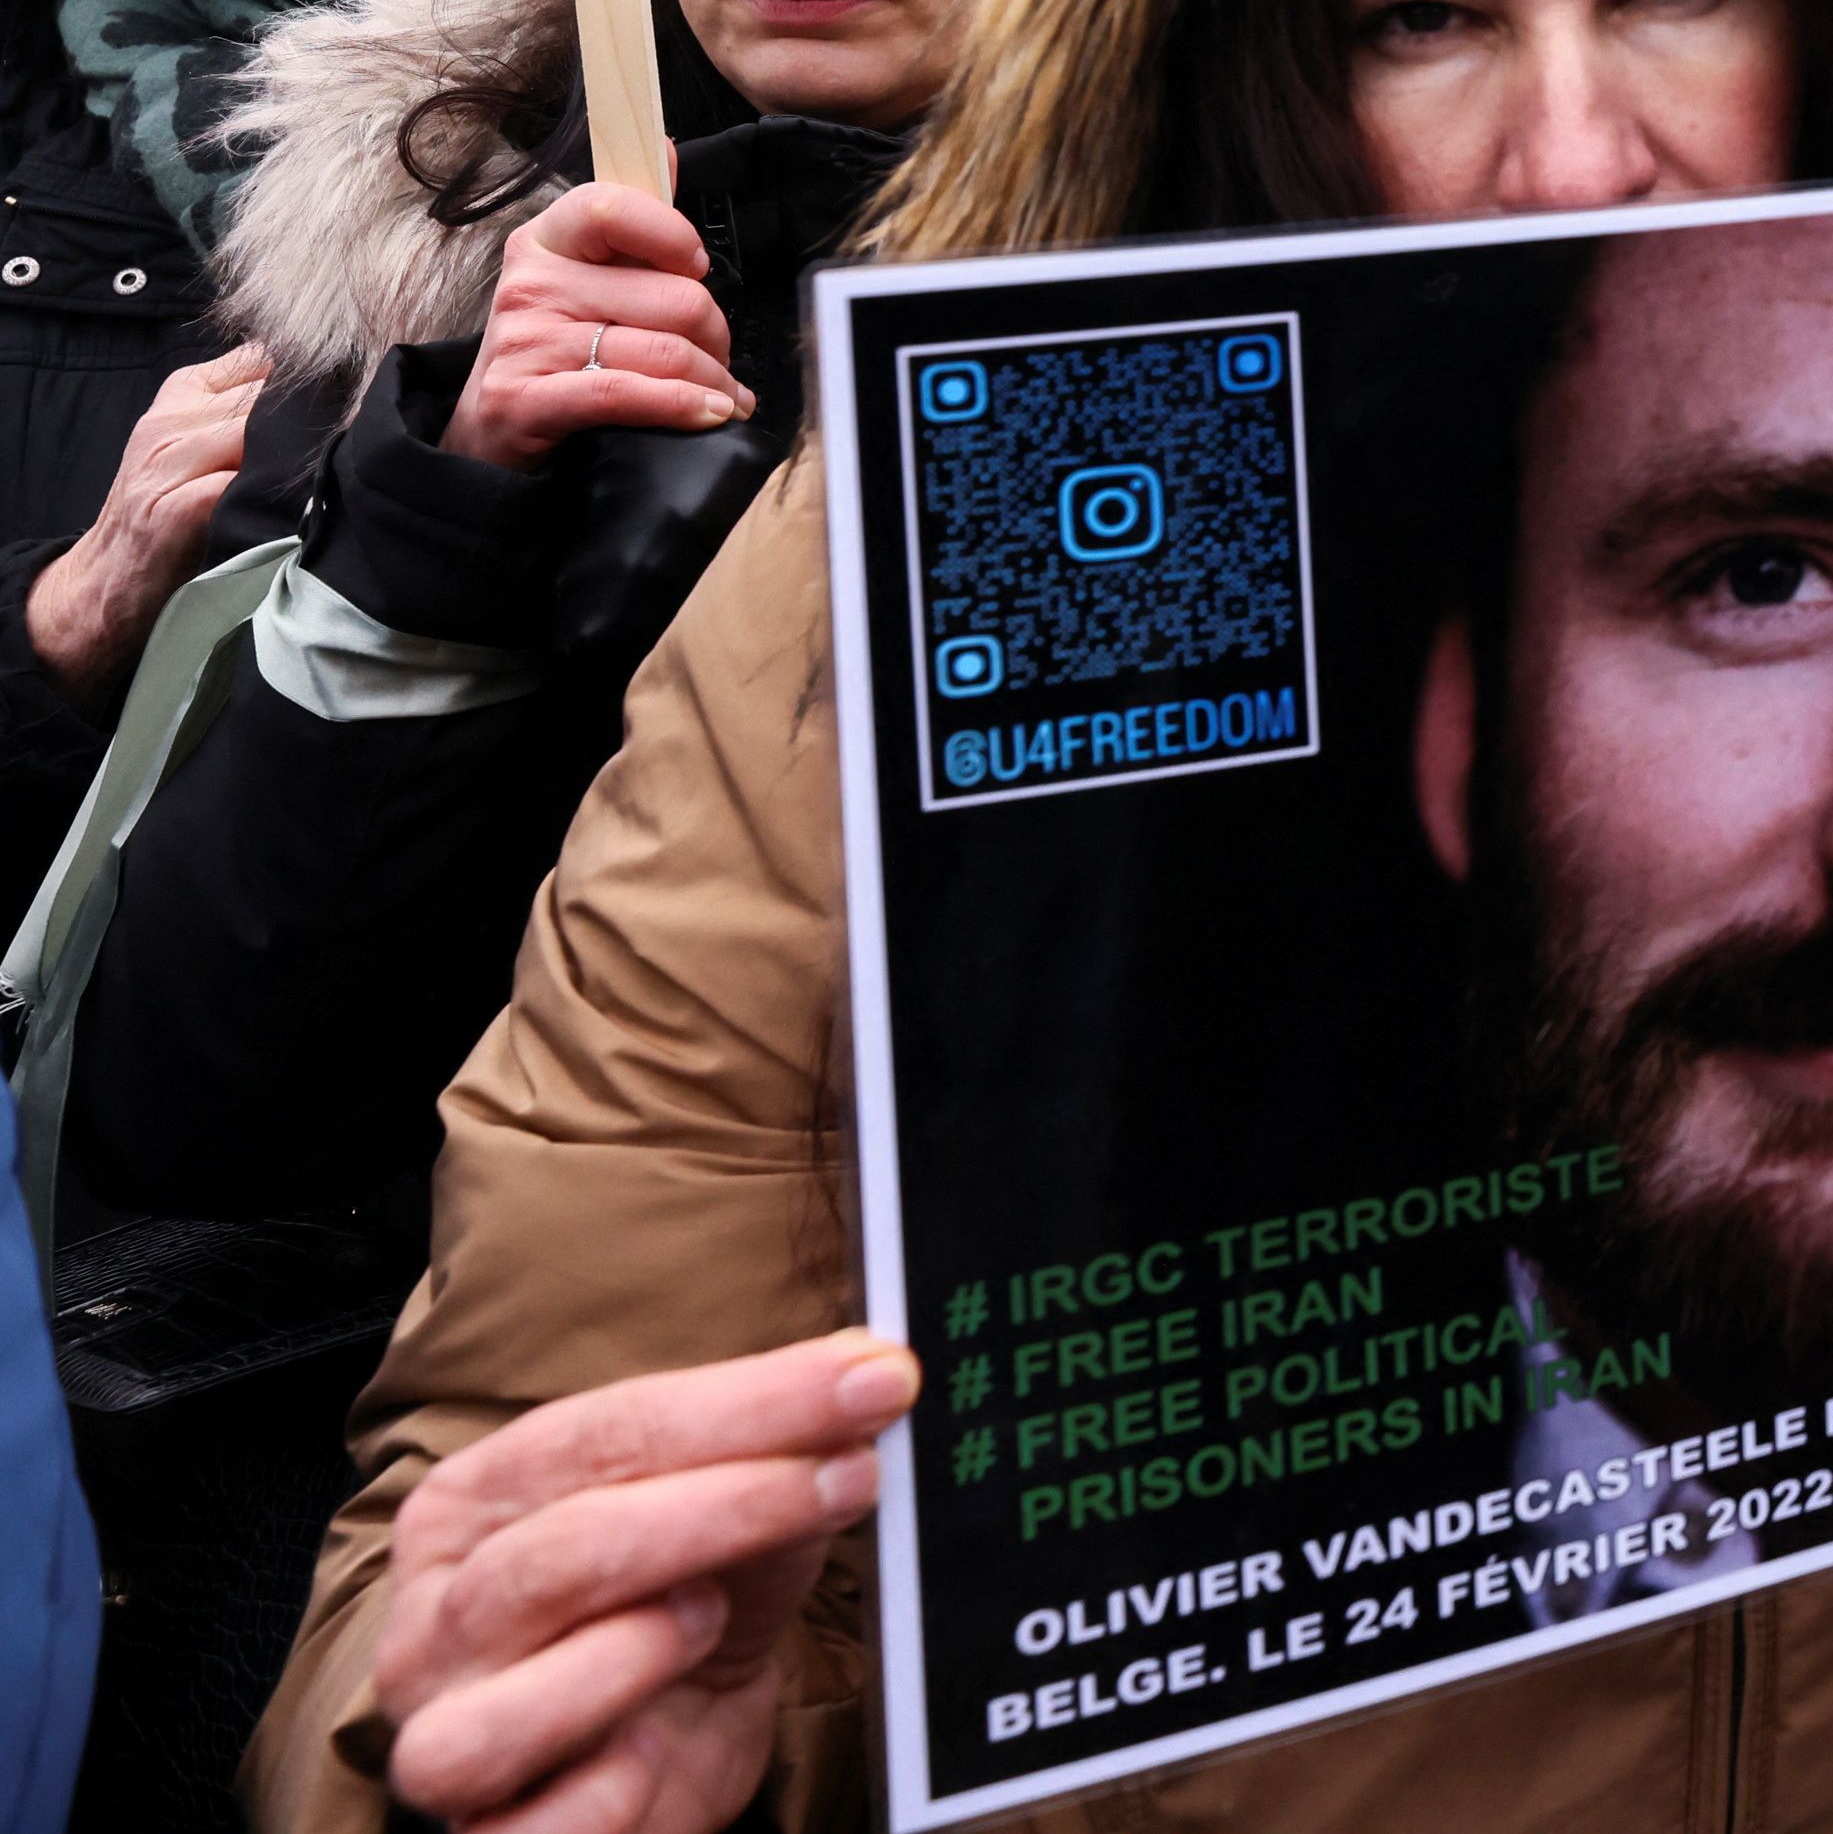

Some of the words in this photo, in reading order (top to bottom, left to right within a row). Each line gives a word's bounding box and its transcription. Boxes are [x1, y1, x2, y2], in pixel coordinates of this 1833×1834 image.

[942, 684, 1298, 790] @U4FREEDOM
[1007, 1241, 1187, 1325] IRGC
[1205, 1144, 1624, 1280] TERRORISTE
[1013, 1307, 1201, 1400] FREE
[1219, 1266, 1385, 1349] IRAN
[1015, 1380, 1204, 1472] FREE
[1223, 1299, 1568, 1421] POLITICAL
[1020, 1396, 1423, 1543] PRISONERS
[1443, 1376, 1505, 1437] IN
[1523, 1331, 1675, 1413] IRAN
[1013, 1548, 1285, 1659] OLIVIER
[1300, 1404, 1808, 1584] VANDECASTEELE
[984, 1640, 1228, 1745] BELGE.
[1246, 1611, 1326, 1674] LE
[1344, 1587, 1420, 1650] 24
[1434, 1514, 1688, 1619] FÉVRIER
